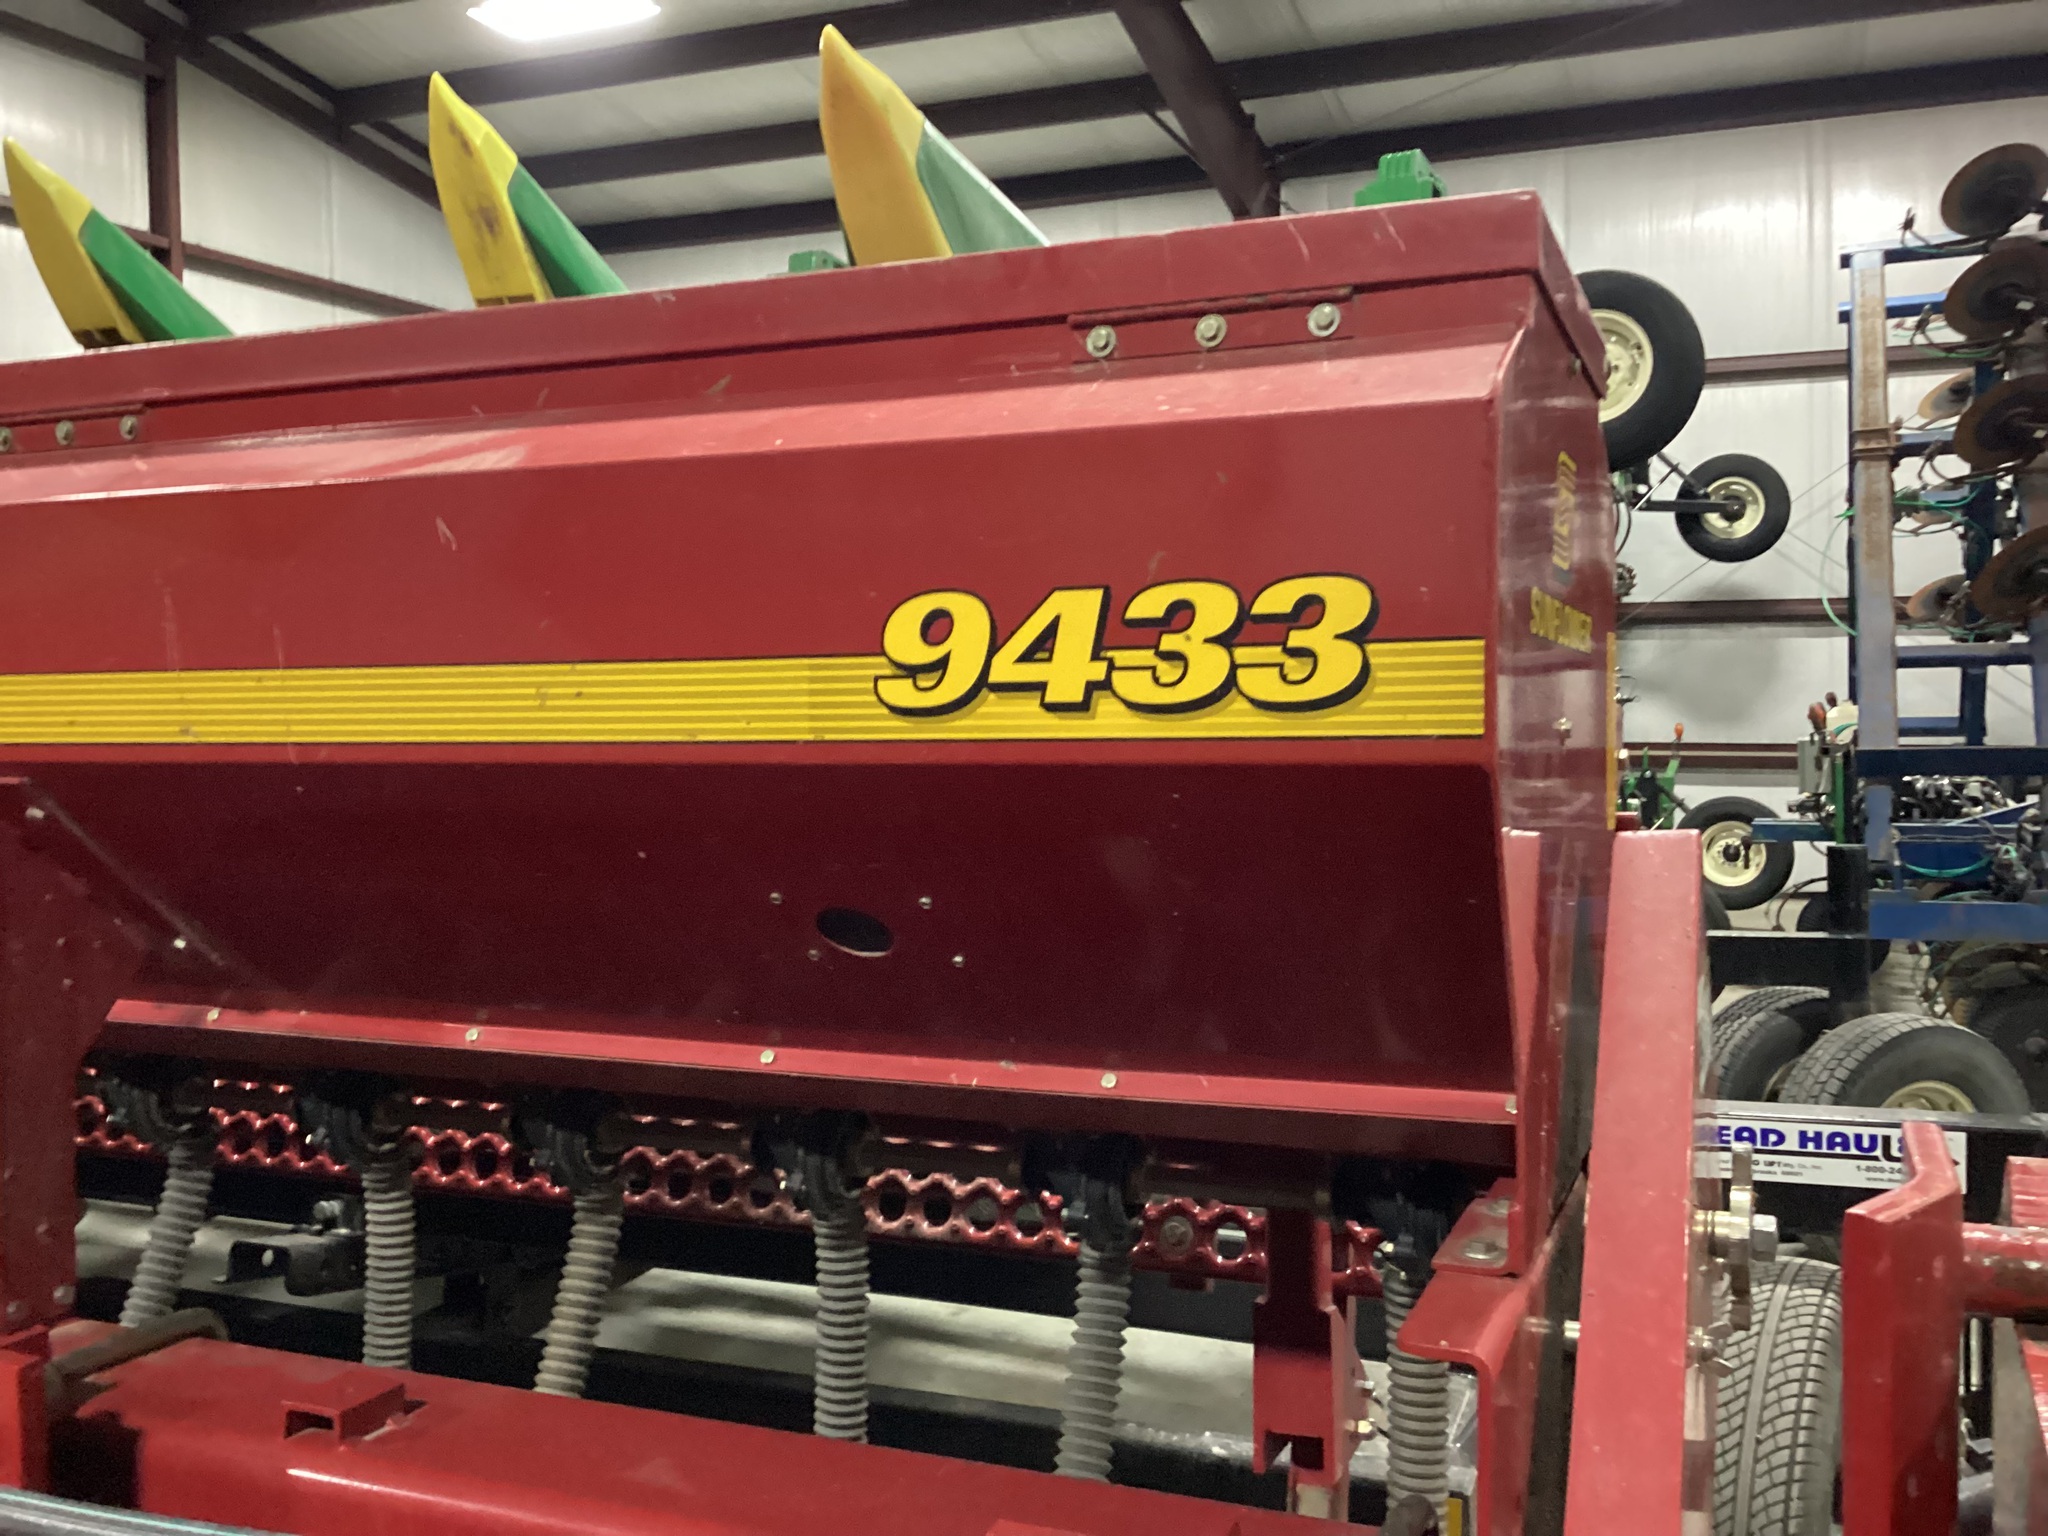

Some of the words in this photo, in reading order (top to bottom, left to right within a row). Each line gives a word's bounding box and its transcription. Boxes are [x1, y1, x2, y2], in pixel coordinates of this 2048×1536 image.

[873, 573, 1380, 716] 9433
[1702, 1125, 1786, 1148] EAD
[1855, 1165, 1903, 1175] 1-800-24
